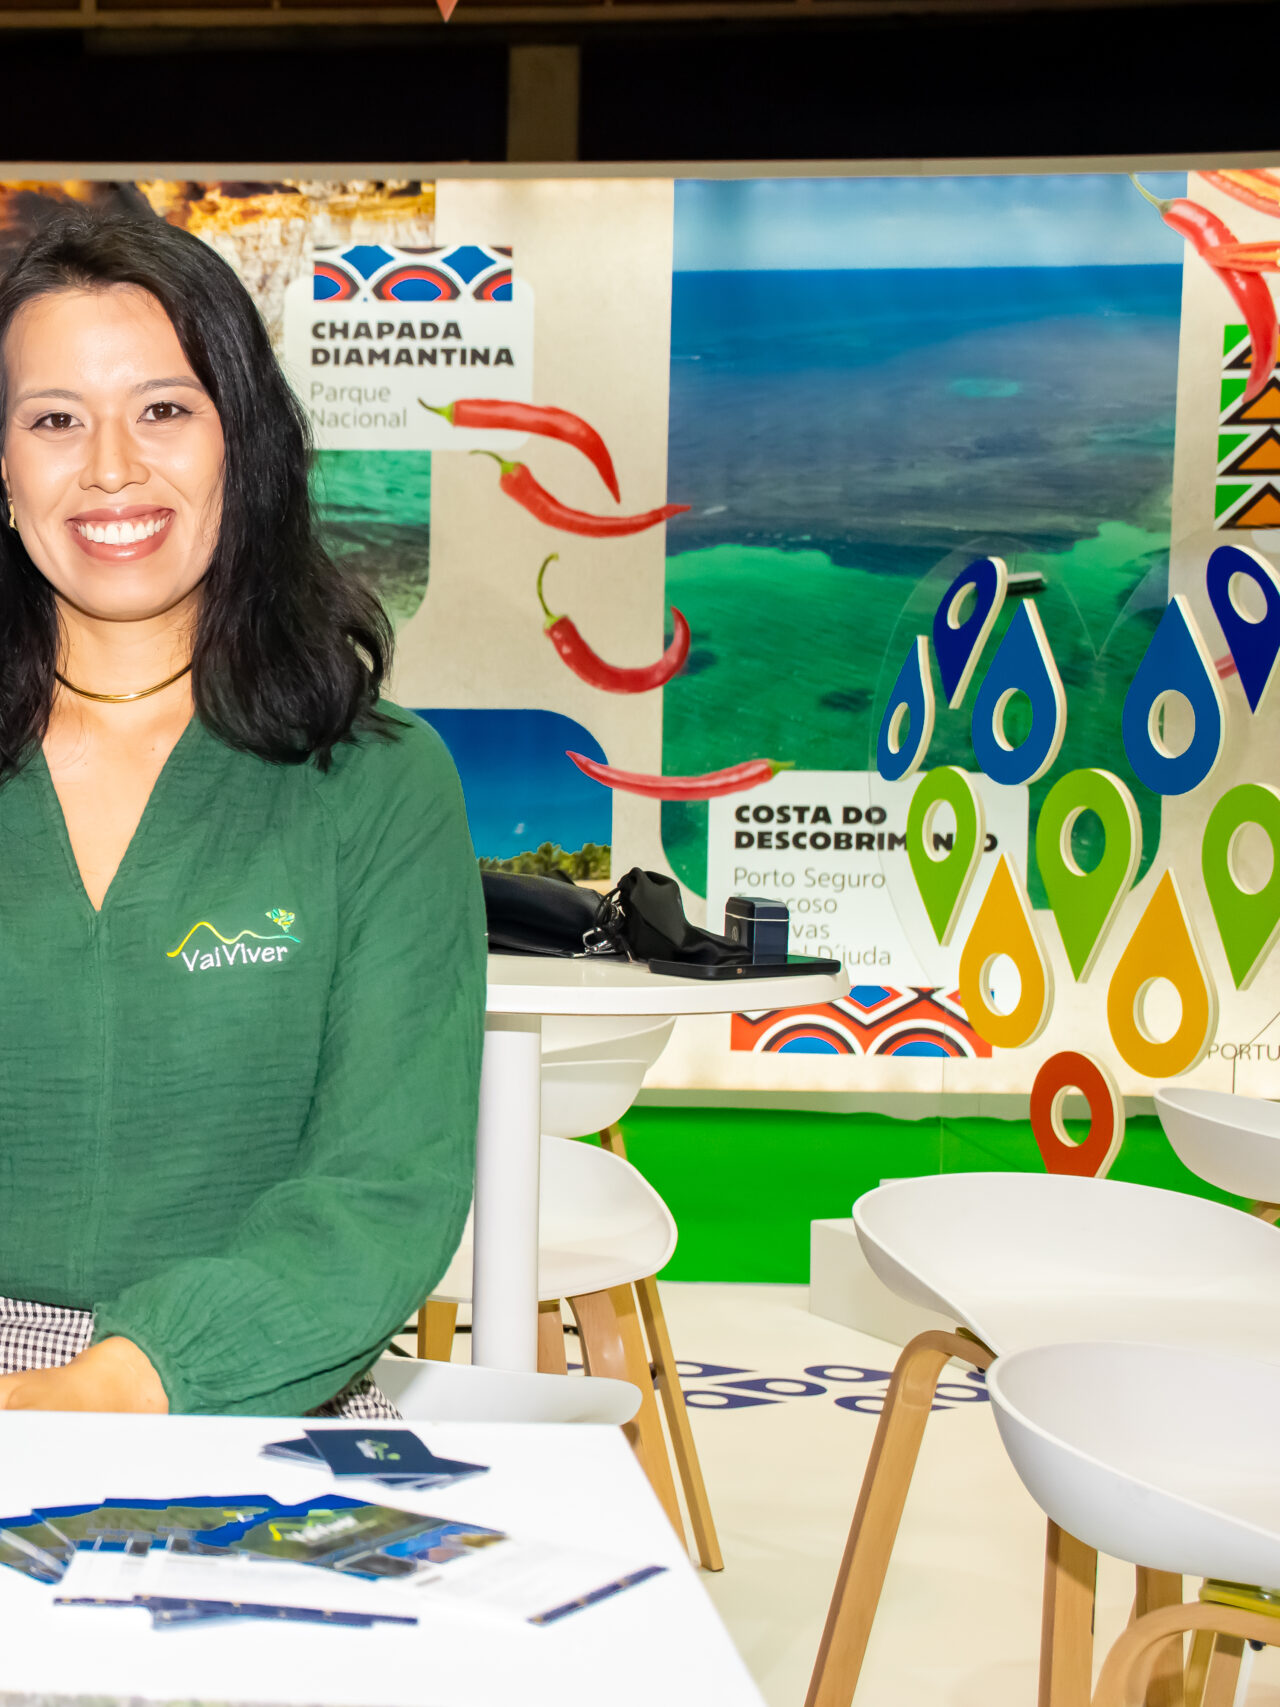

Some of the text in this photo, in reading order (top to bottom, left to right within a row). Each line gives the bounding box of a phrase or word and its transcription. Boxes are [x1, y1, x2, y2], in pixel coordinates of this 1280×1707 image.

[311, 321, 462, 340] CHAPADA
[311, 348, 515, 367] DIAMANTINA
[310, 381, 391, 405] Parque
[312, 408, 408, 428] Nacional
[734, 805, 888, 825] COSTA DO
[734, 831, 999, 852] DESCOBRIMNO
[734, 867, 887, 893] Porto Seguro
